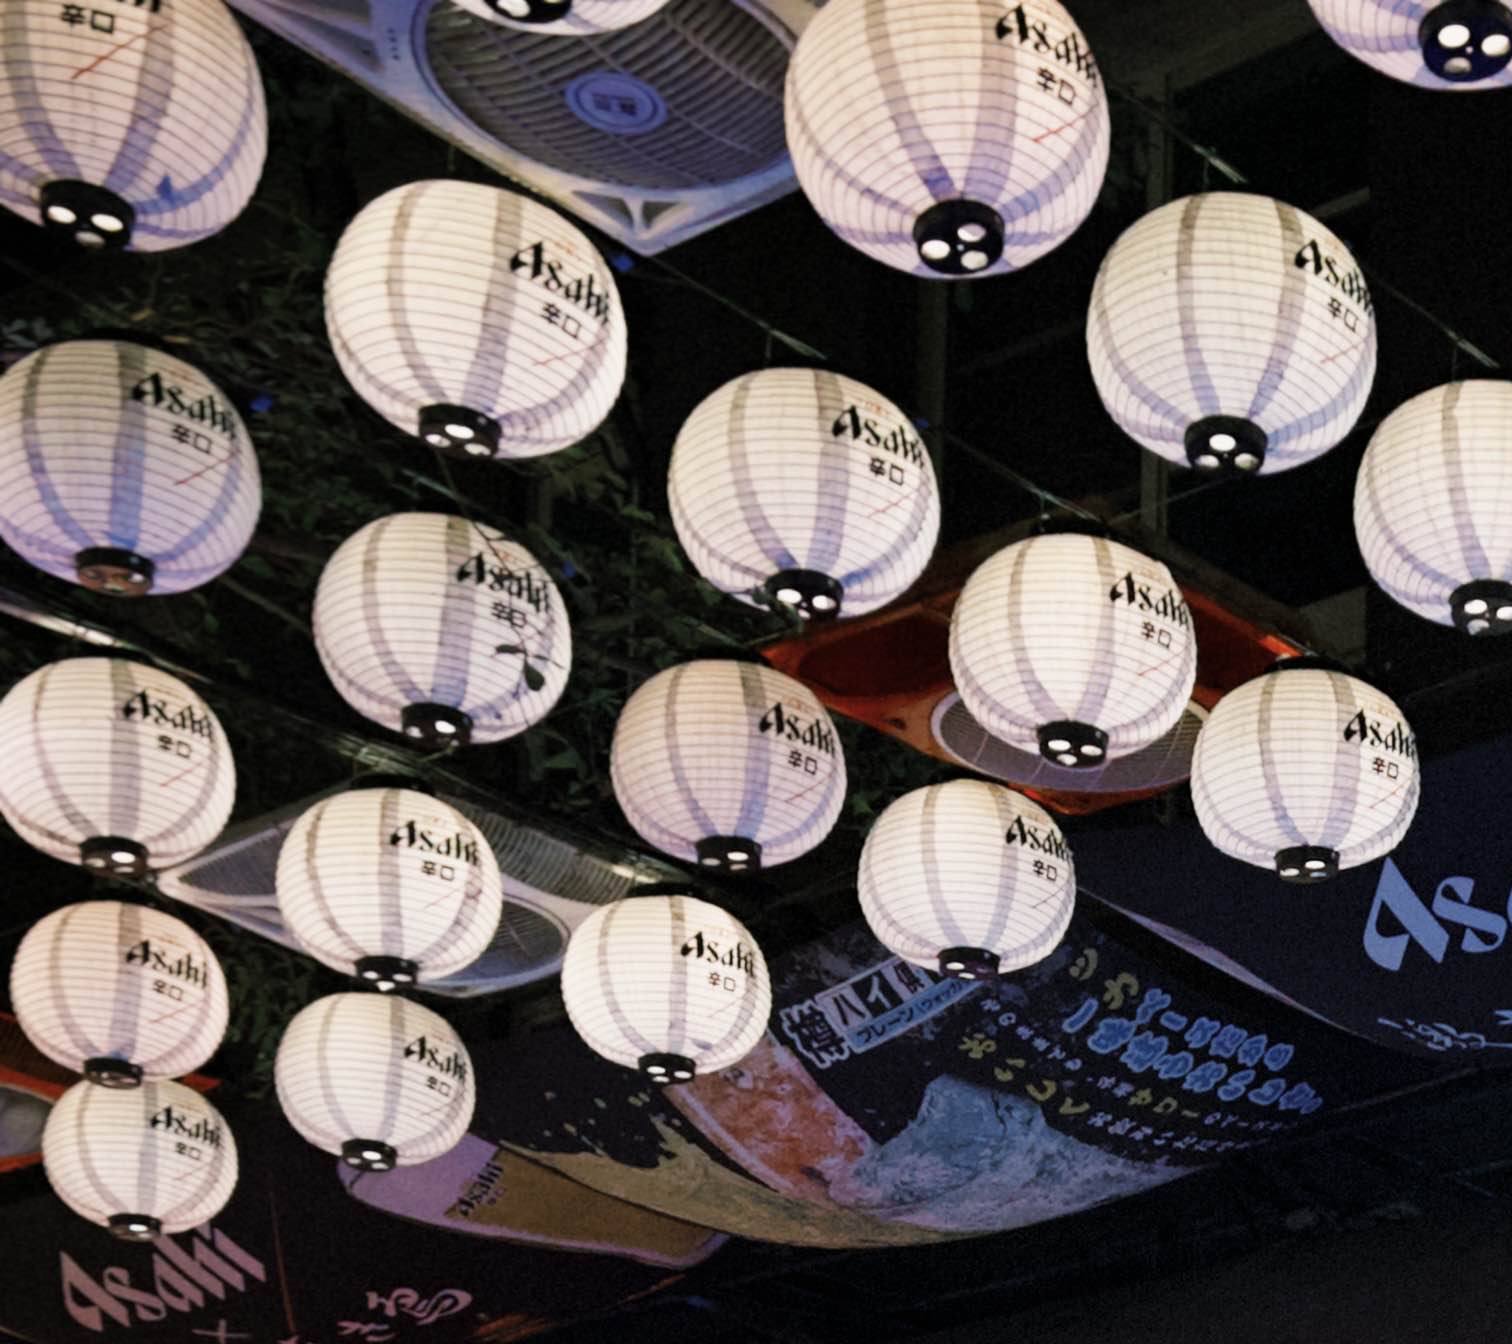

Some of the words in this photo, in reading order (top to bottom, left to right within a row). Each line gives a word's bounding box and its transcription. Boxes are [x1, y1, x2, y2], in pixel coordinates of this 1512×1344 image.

[61, 4, 115, 34] 辛口
[1037, 67, 1076, 106] 辛口
[511, 241, 611, 325] Asahi
[540, 301, 581, 338] 辛口
[1328, 295, 1359, 331] 辛口
[132, 372, 238, 442] Asahi
[172, 424, 212, 455] 辛口
[869, 457, 905, 485] 辛口
[1141, 621, 1171, 648] 辛口
[122, 690, 217, 741] Asahi
[759, 702, 836, 757] Asahi
[158, 736, 192, 759] 辛口
[789, 749, 818, 775] 辛口
[1372, 757, 1398, 779] 辛口
[390, 820, 479, 867] Asahi
[421, 860, 455, 881] 辛口
[1033, 859, 1057, 881] 辛口
[127, 940, 209, 988] Asahi
[680, 931, 757, 978] Asahi
[709, 973, 736, 991] 辛口
[152, 1105, 223, 1148] Asahi
